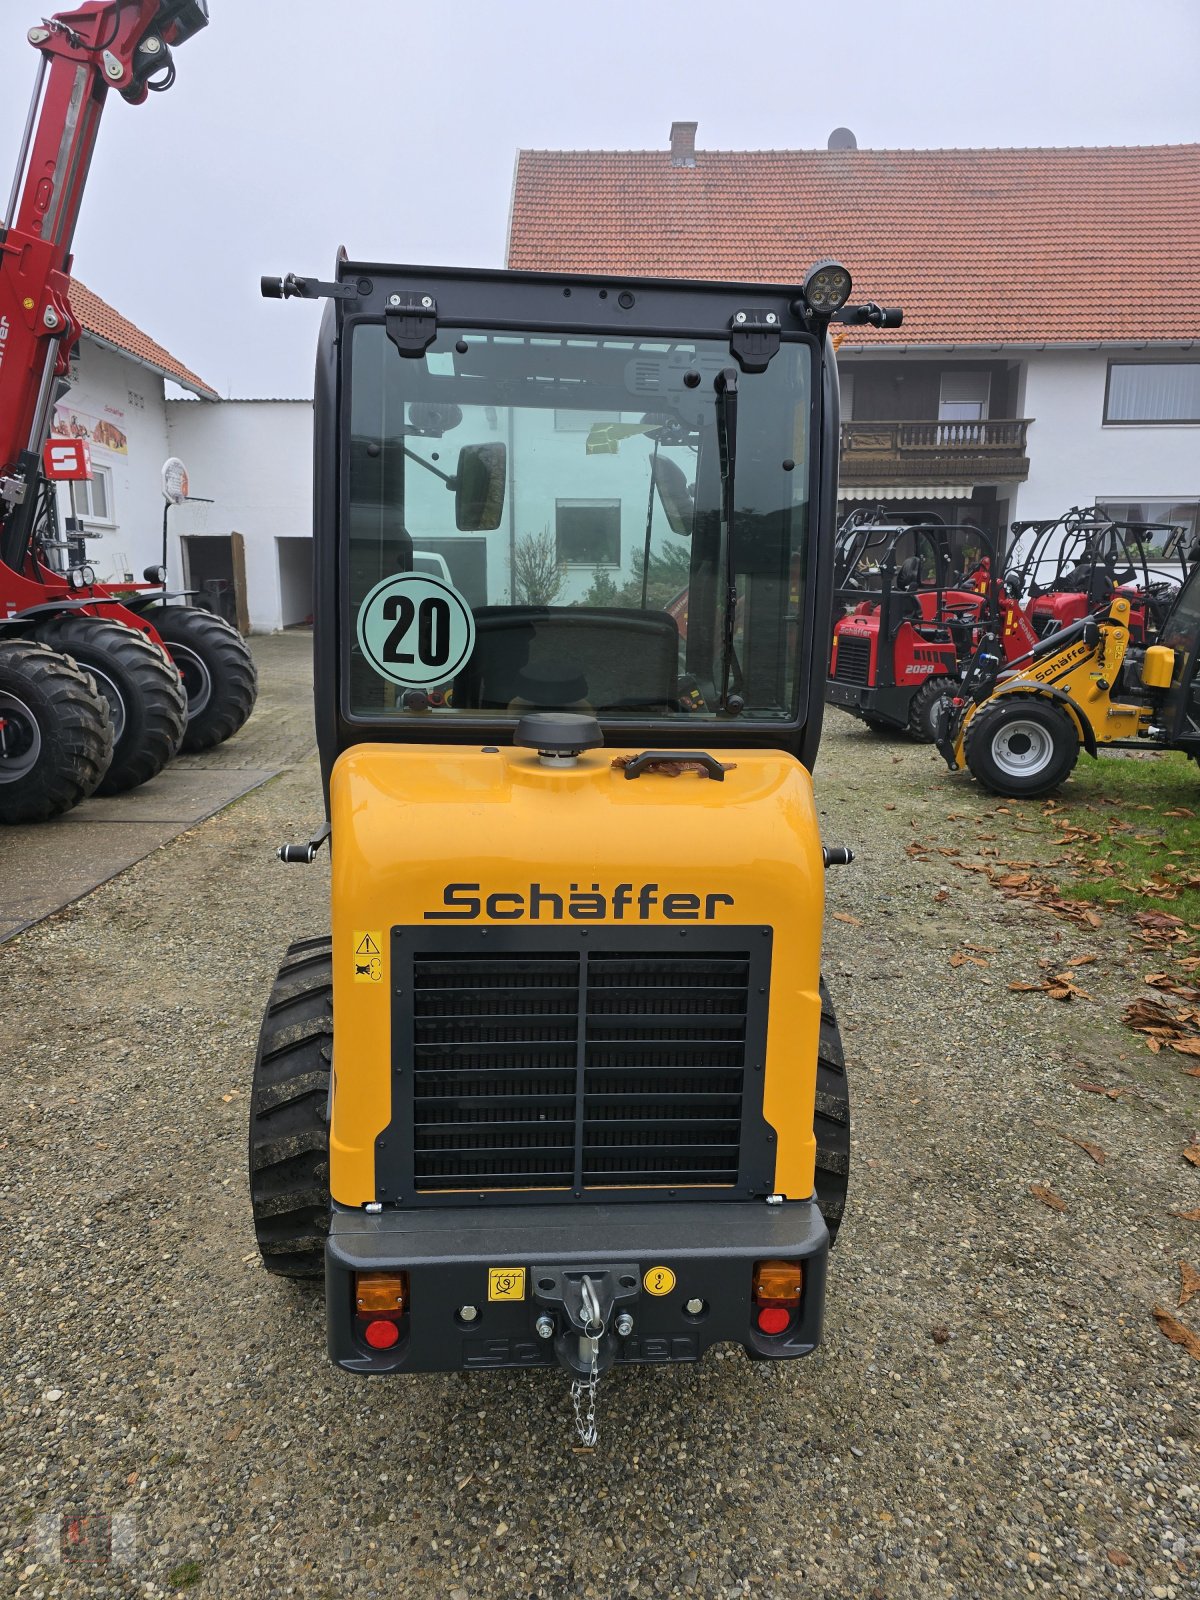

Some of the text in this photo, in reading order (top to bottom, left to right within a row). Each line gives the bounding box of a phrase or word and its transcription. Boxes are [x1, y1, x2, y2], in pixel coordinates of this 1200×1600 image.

[383, 595, 450, 667] 20
[839, 626, 872, 637] Schäffer
[905, 664, 935, 674] 2028
[1035, 646, 1086, 682] Schäffe
[423, 883, 735, 920] Schäffer
